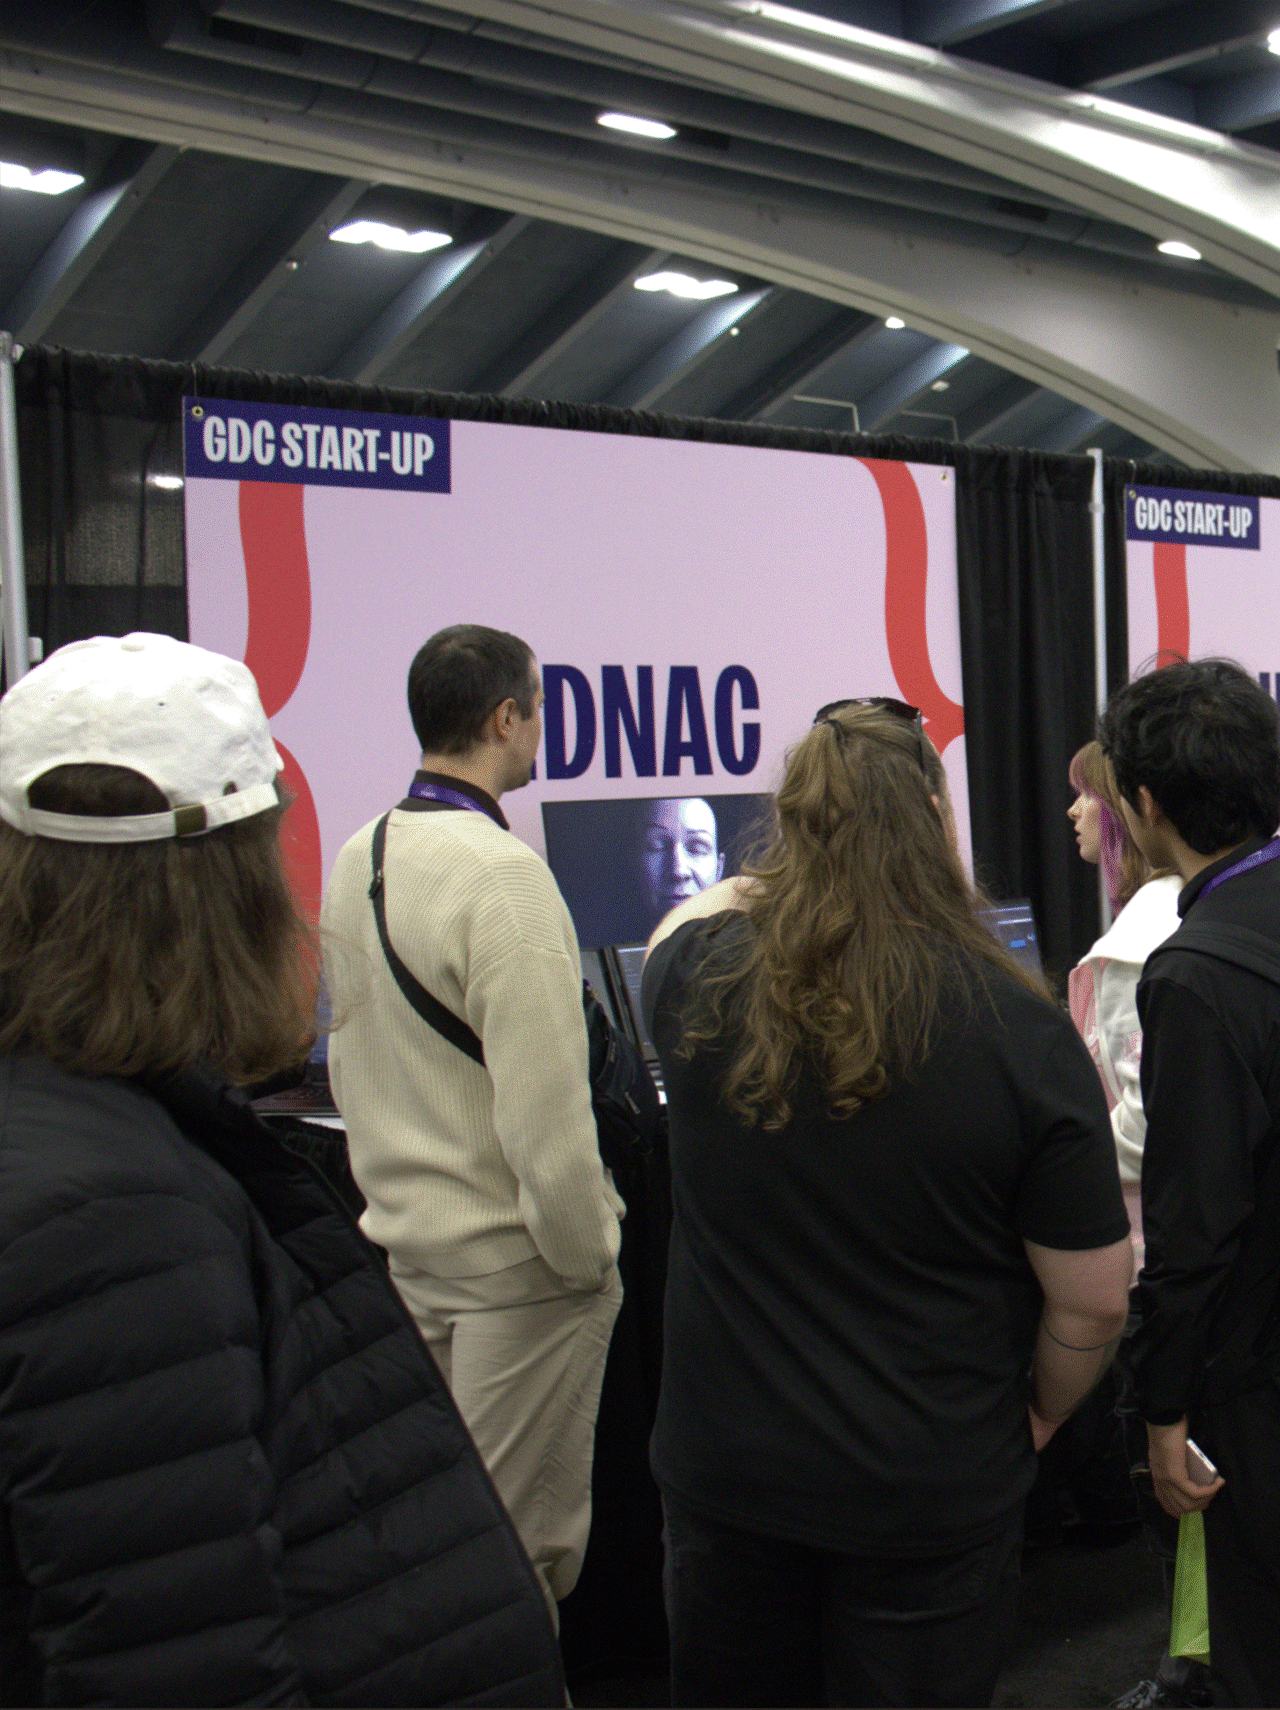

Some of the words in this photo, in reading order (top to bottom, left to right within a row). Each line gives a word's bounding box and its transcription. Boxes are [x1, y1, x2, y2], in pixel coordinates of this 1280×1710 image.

[203, 415, 276, 466] GDC
[281, 421, 435, 476] START-UP
[1135, 496, 1173, 530] GDC
[1174, 500, 1253, 538] START-UP
[530, 664, 761, 780] DNAC
